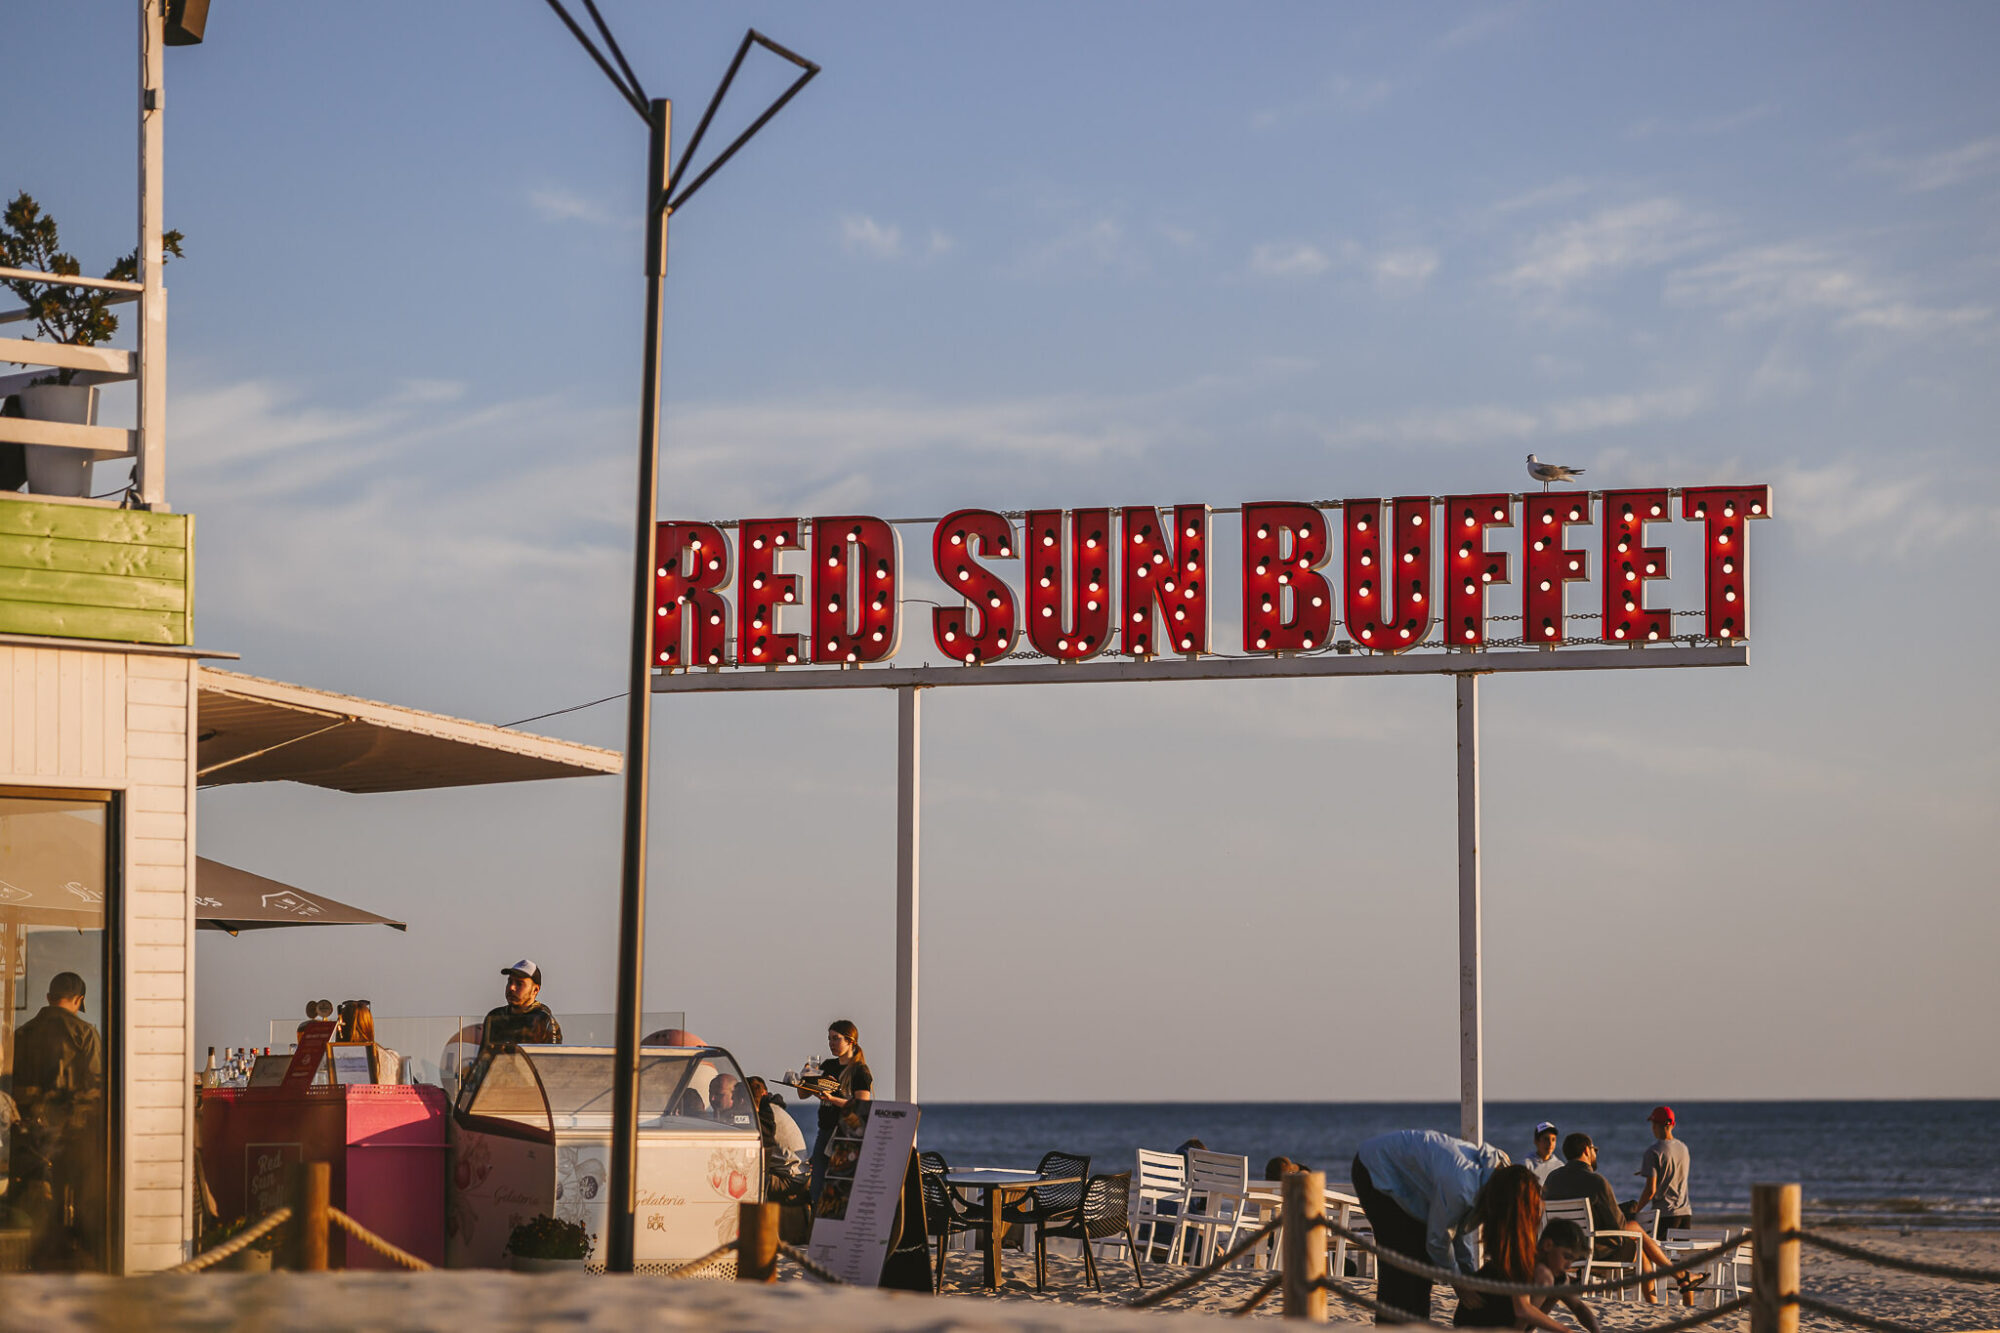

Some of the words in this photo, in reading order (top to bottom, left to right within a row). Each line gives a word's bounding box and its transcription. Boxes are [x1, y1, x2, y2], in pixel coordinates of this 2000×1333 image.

[653, 515, 902, 667] RED
[933, 503, 1212, 662] SUN
[1242, 484, 1773, 654] BUFFET
[257, 1149, 283, 1174] Red
[251, 1173, 275, 1194] Sun
